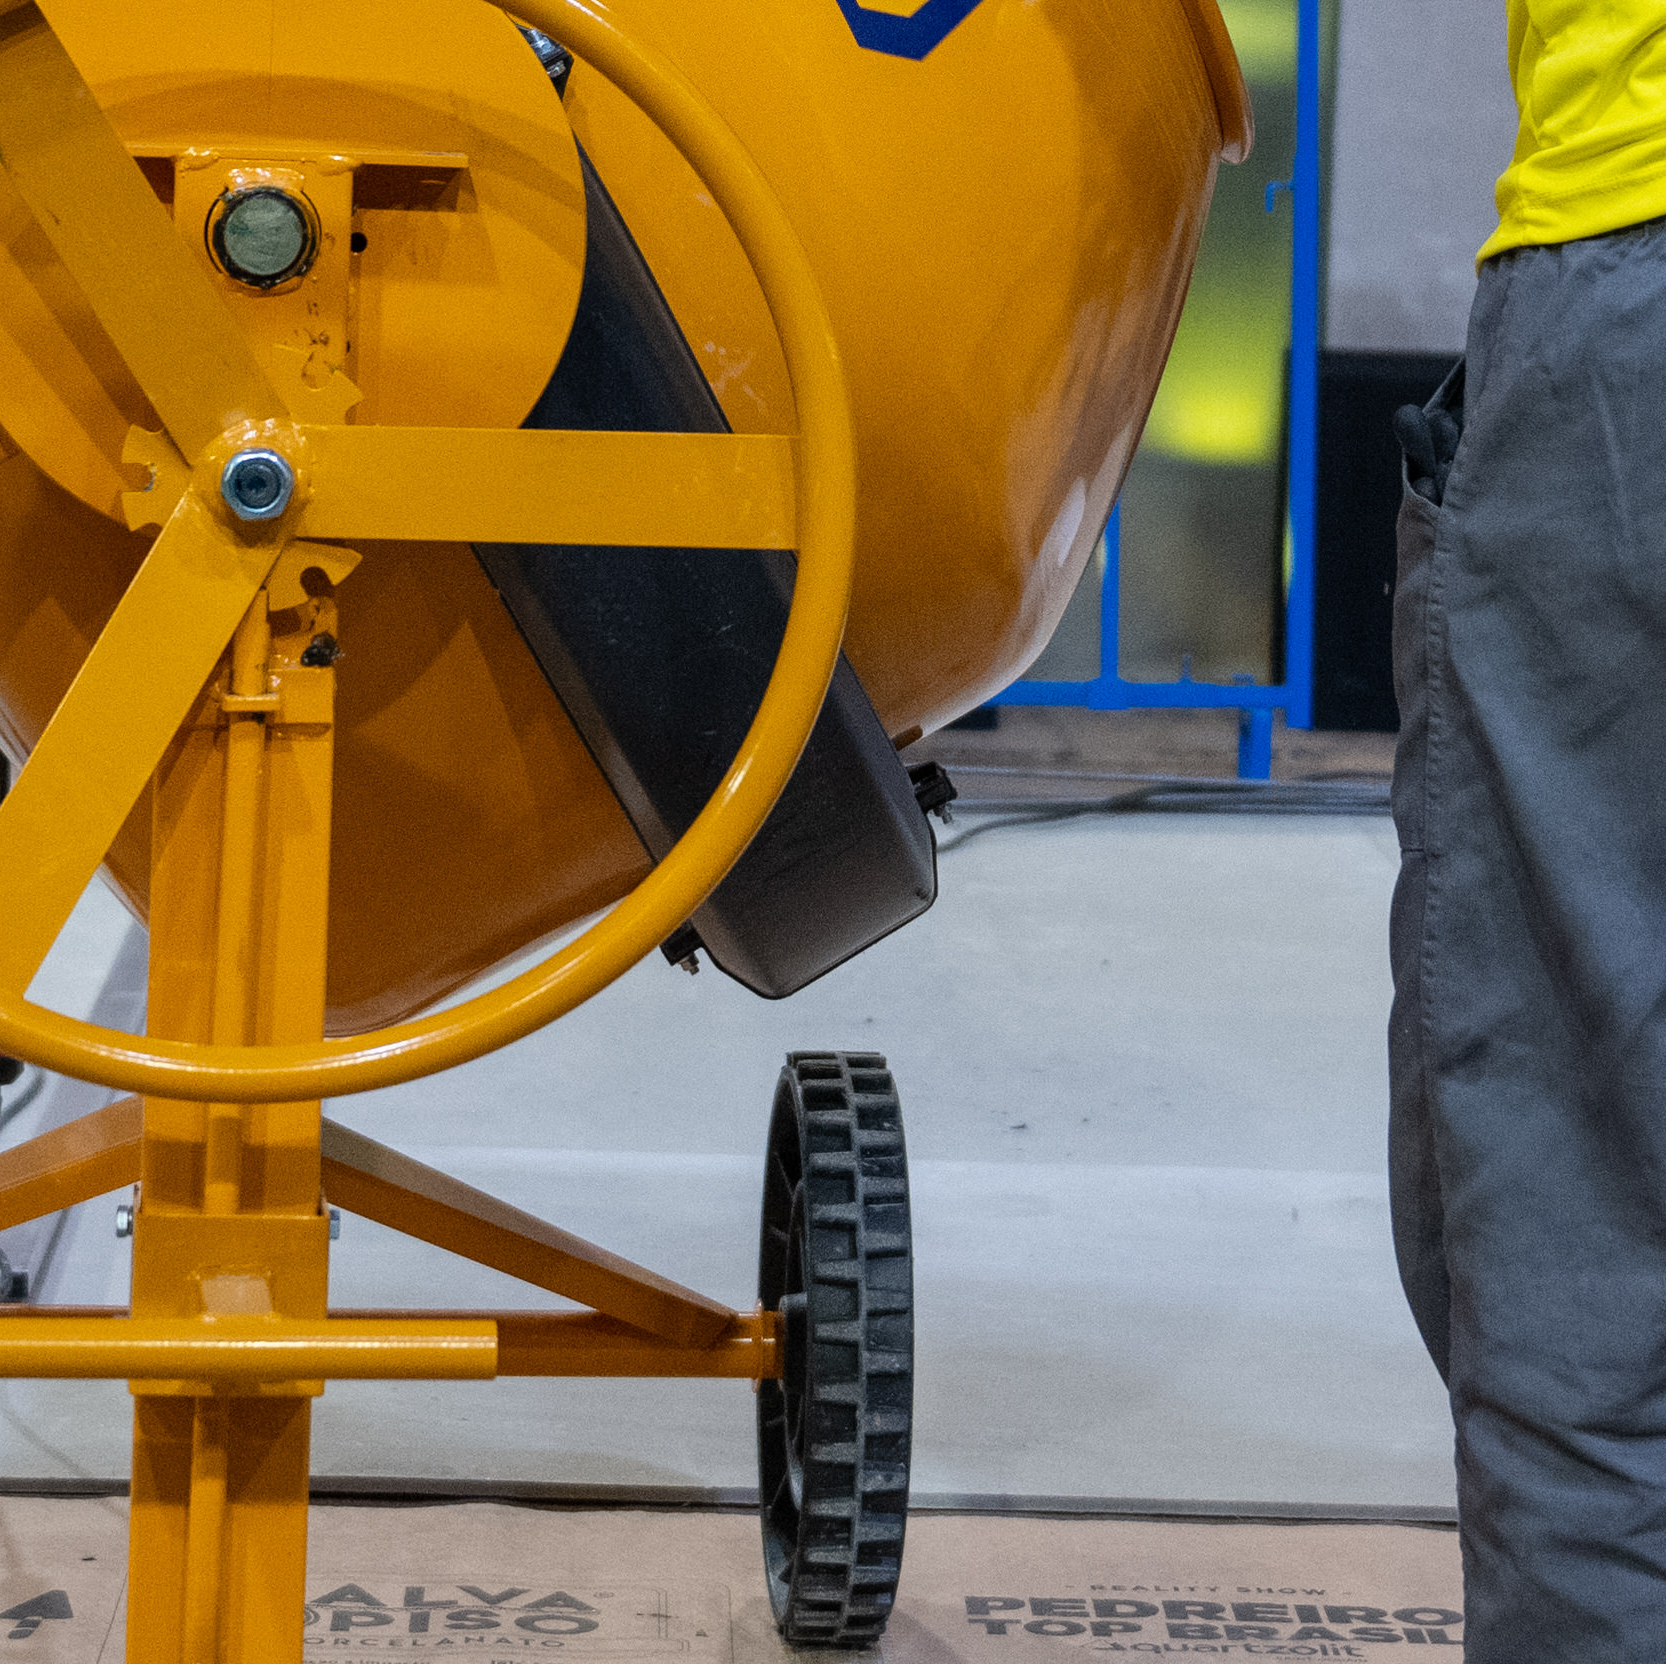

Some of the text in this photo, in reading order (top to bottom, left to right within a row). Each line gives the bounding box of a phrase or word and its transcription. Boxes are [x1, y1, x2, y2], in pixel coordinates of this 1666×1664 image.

[309, 1582, 598, 1610] ALVA
[1090, 1585, 1326, 1596] REALITY SHOW
[964, 1595, 1465, 1627] PEDREIRO
[304, 1636, 566, 1648] ORCELANATO
[967, 1618, 1465, 1646] TOP BRASIL
[1130, 1640, 1366, 1659] quartzolit
